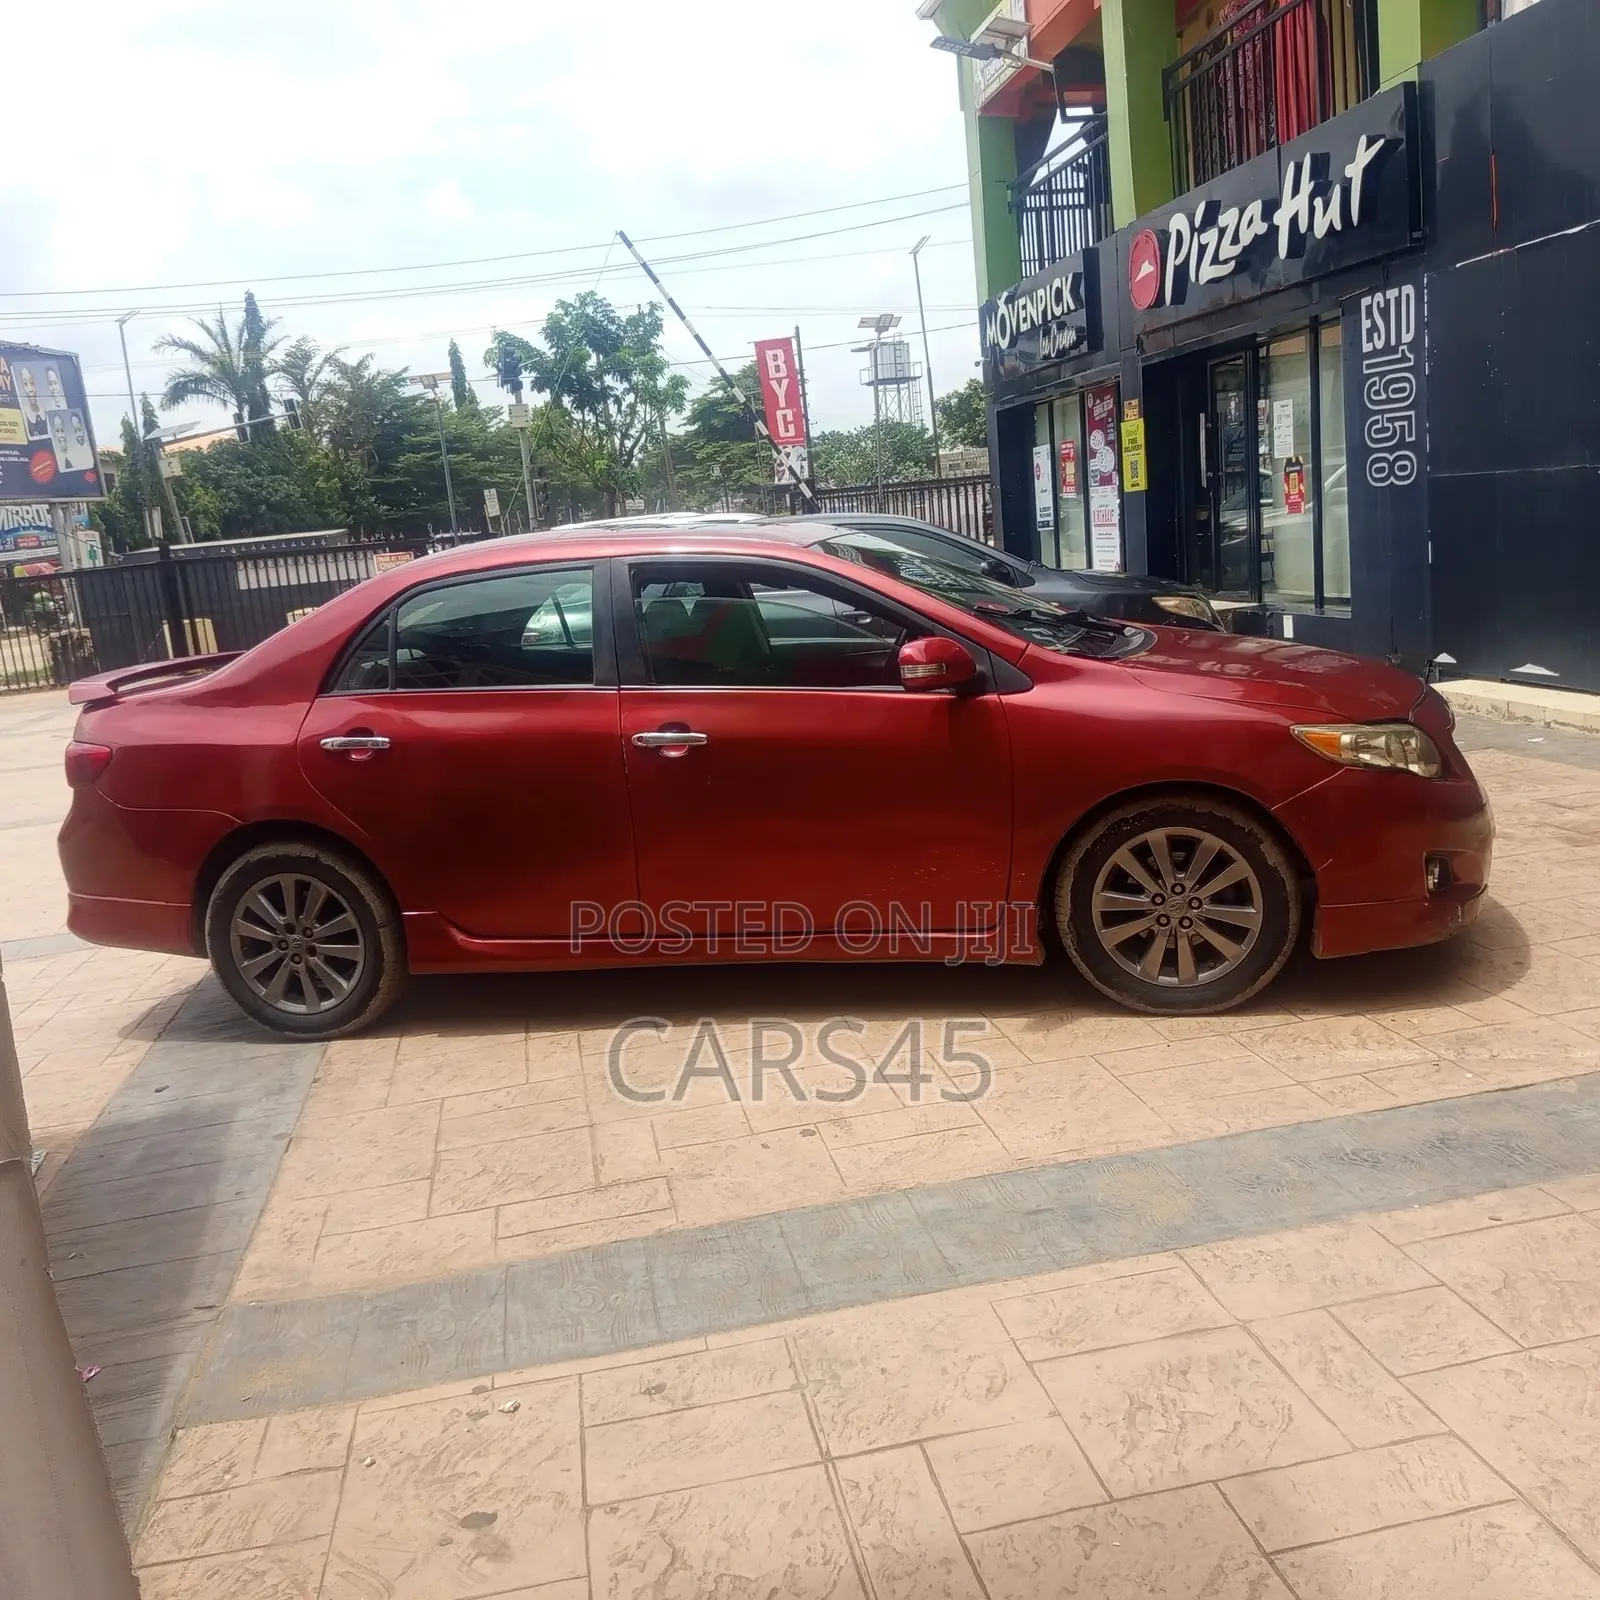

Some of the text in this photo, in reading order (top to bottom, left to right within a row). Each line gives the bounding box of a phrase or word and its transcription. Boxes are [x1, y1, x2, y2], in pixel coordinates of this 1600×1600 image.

[1165, 134, 1385, 307] Pizza Hut
[1360, 284, 1415, 353] ESTD
[765, 349, 796, 437] BYC
[1363, 345, 1417, 487] 1958
